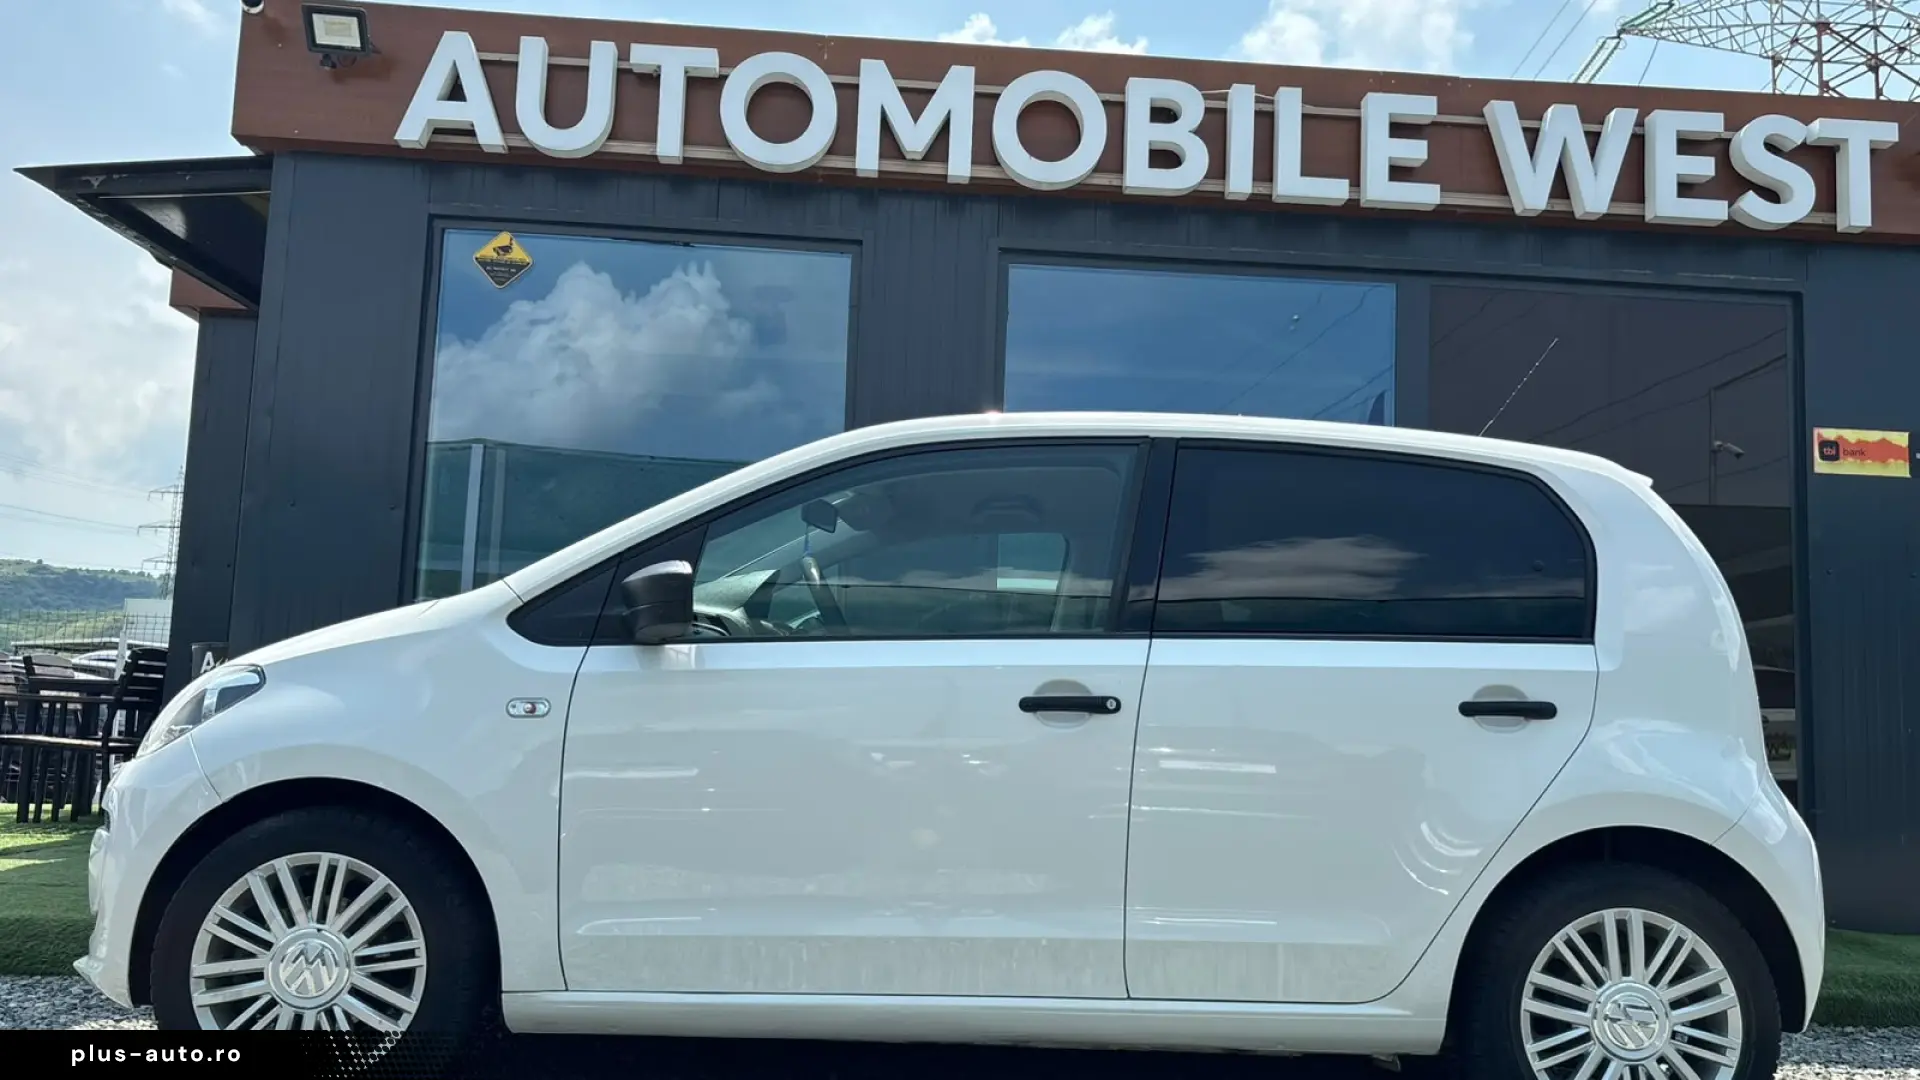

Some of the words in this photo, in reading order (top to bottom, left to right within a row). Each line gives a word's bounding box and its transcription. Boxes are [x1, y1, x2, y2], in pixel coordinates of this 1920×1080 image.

[394, 30, 1441, 209] AUTOMOBILE
[1483, 99, 1900, 233] WEST
[1842, 448, 1866, 457] bank
